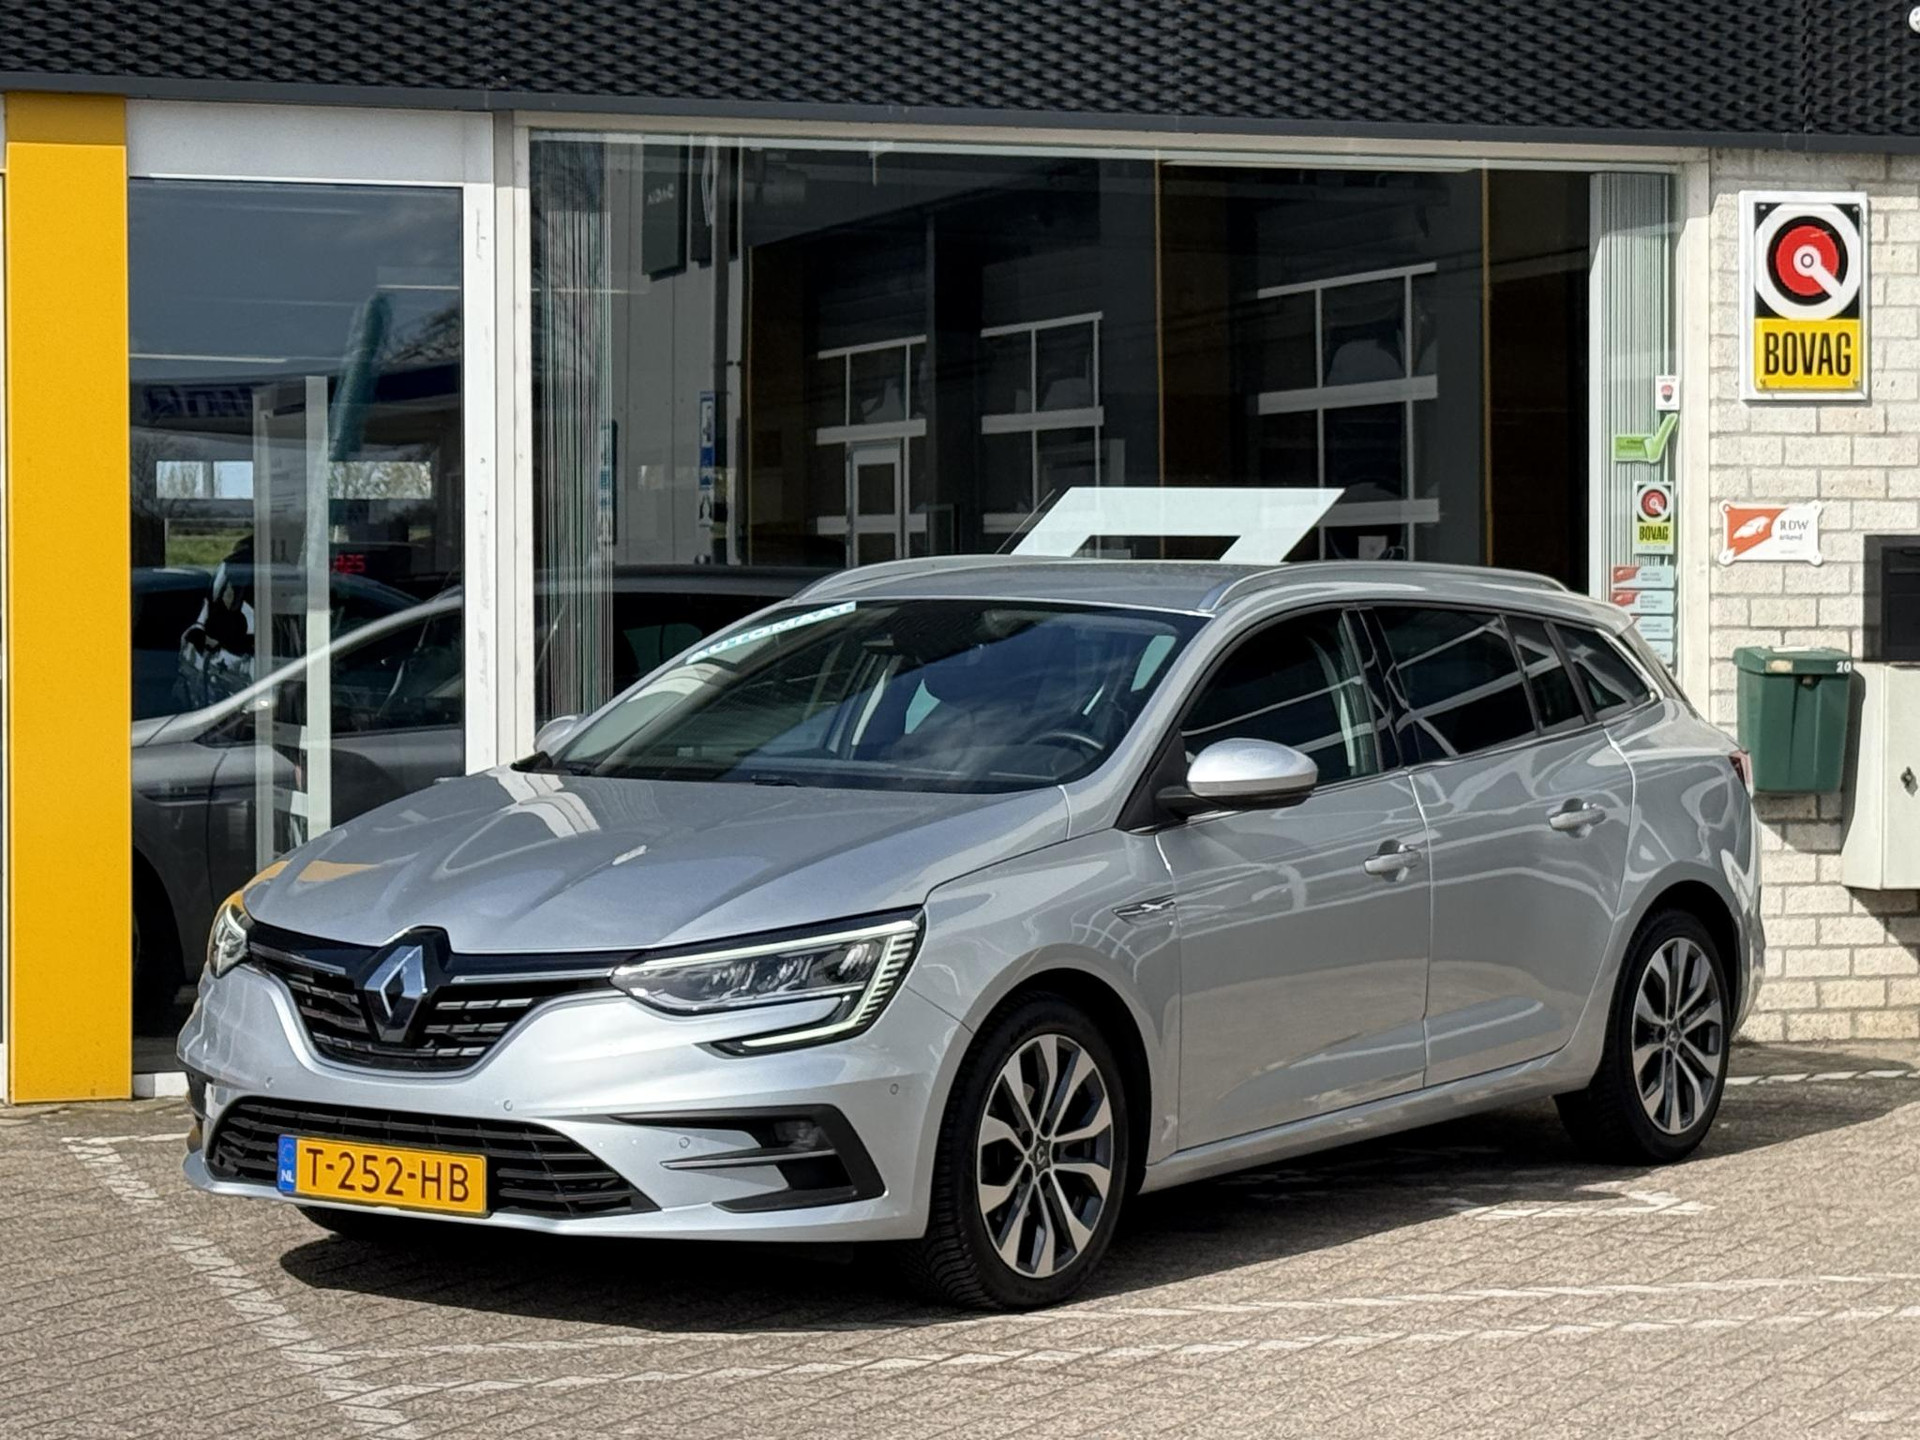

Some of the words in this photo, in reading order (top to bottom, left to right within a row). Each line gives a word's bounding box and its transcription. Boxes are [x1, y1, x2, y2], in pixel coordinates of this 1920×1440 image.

[1764, 331, 1851, 376] BOVAG
[1639, 525, 1669, 541] BOVAG
[1836, 660, 1851, 673] 20
[281, 1169, 294, 1183] NL
[306, 1148, 469, 1202] T-252-HB
